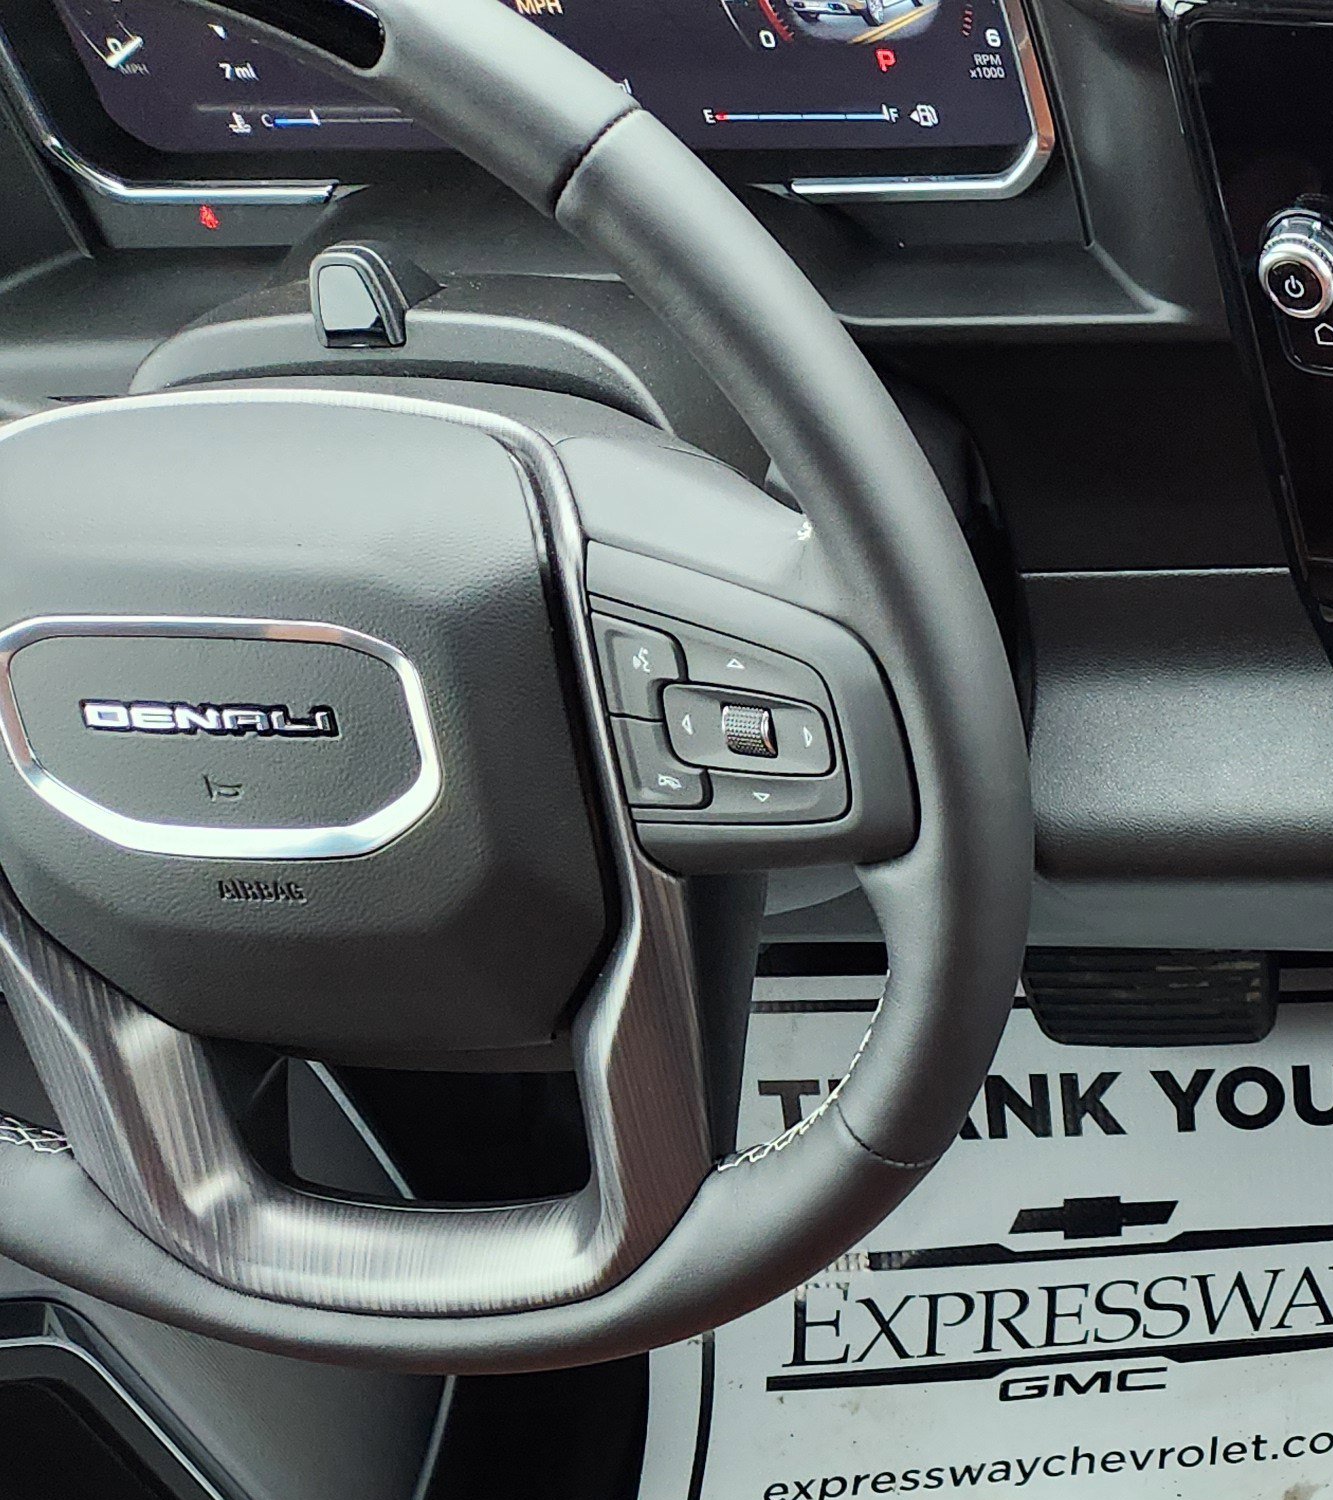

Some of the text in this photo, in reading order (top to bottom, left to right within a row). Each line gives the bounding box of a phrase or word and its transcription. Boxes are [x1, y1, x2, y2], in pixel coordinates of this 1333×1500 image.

[985, 29, 1001, 47] 6
[218, 62, 233, 80] 7
[876, 49, 897, 72] P
[974, 53, 1002, 66] RPM
[702, 109, 716, 123] E
[80, 699, 340, 737] DENALI
[217, 879, 307, 904] AIRBAG
[758, 1070, 1127, 1141] TNK
[1000, 1366, 1169, 1402] GMC
